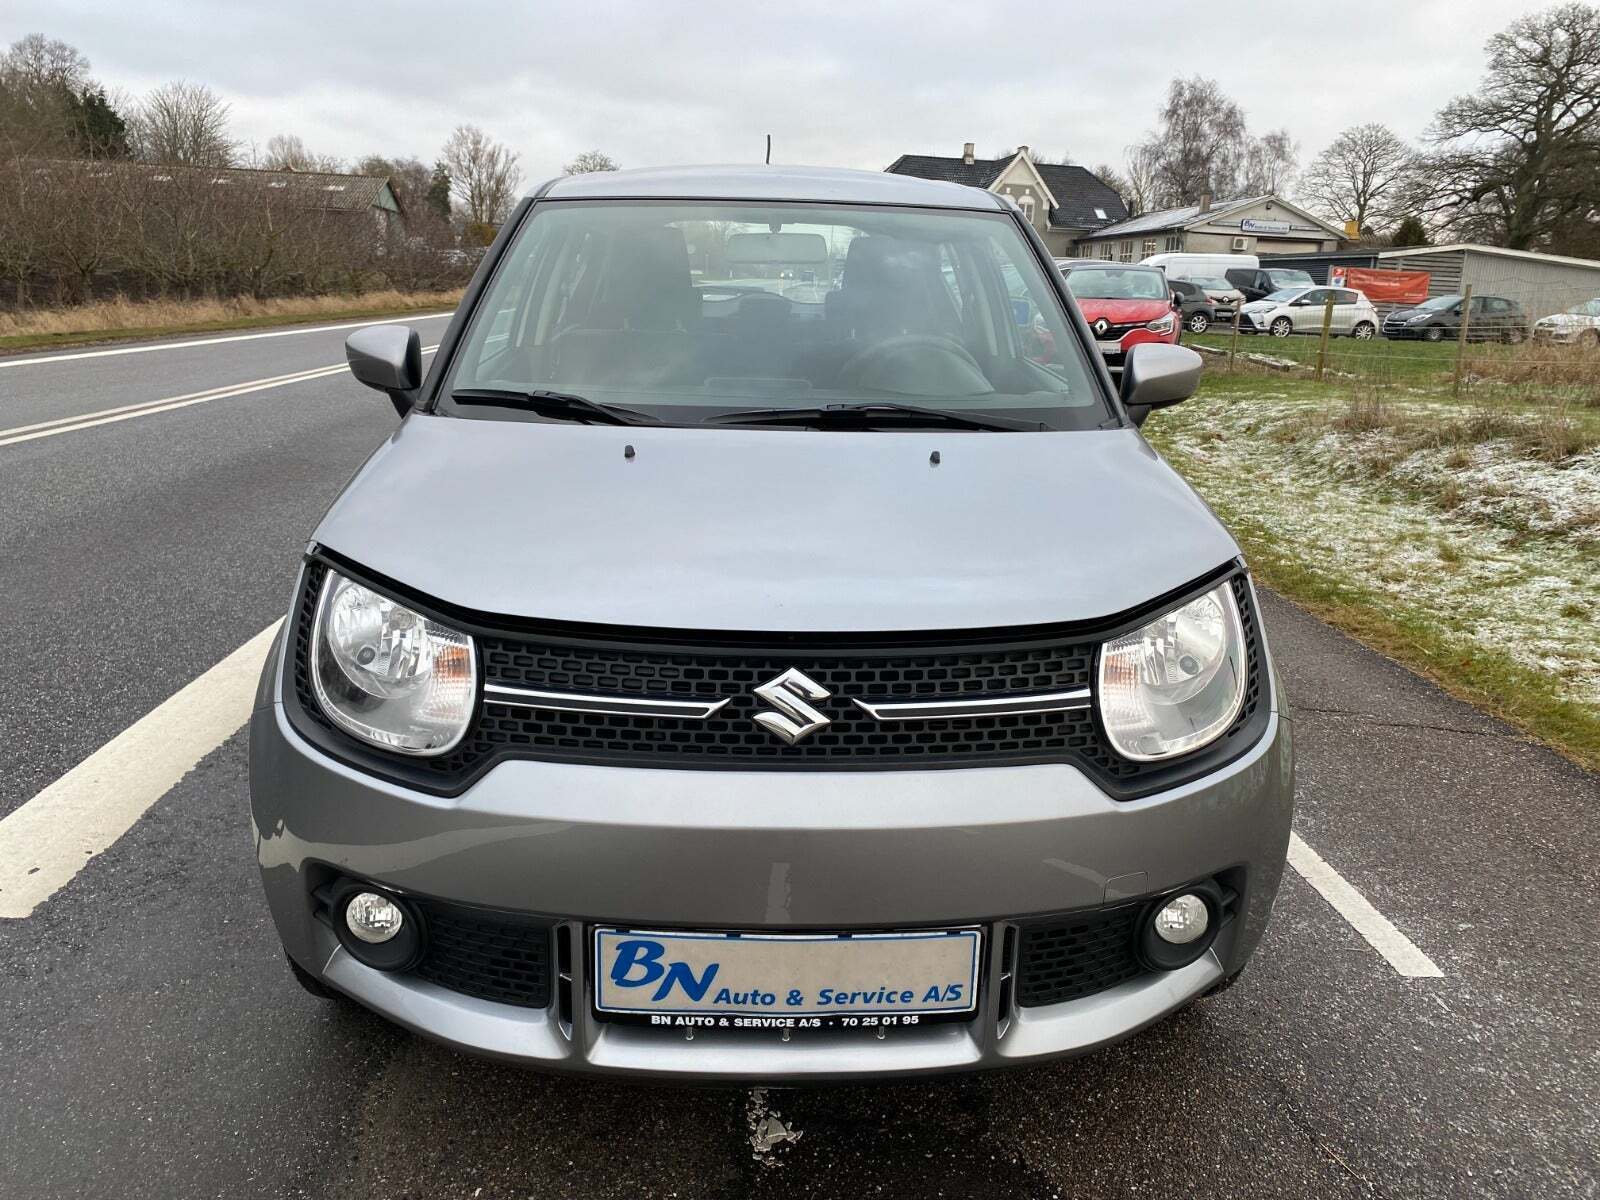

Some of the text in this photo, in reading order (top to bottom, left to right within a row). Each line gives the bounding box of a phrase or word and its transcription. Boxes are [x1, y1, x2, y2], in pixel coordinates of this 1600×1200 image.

[610, 940, 964, 1006] BN Auto & Service A/S
[651, 1015, 920, 1028] BN AUTO & SERVICE A/S 70 25 01 95
